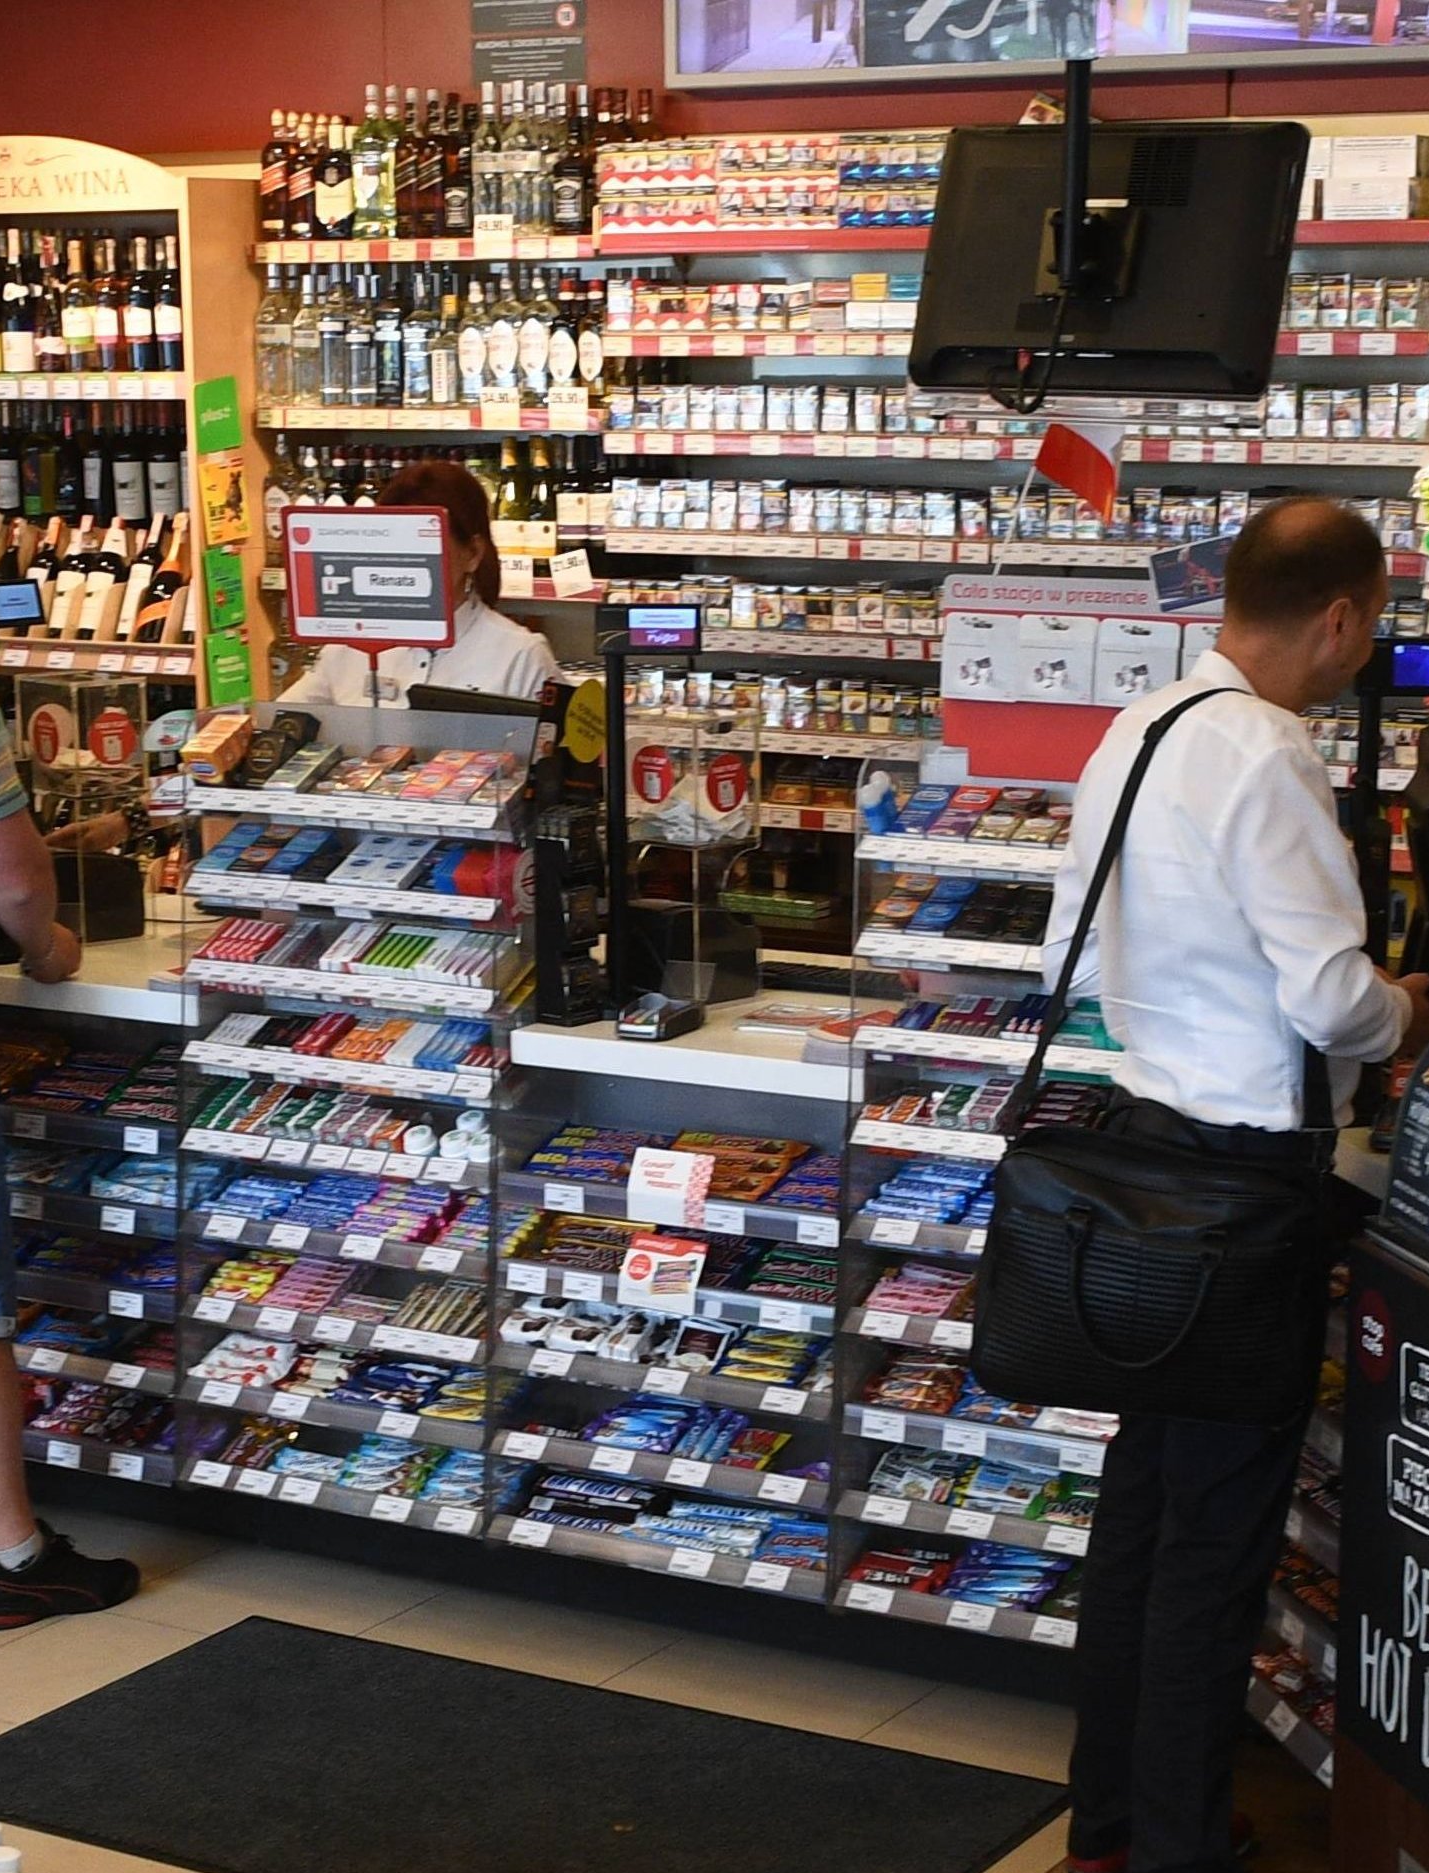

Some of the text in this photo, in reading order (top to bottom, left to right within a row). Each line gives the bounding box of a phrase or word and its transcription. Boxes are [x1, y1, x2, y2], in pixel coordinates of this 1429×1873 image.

[54, 169, 130, 196] WINA
[369, 572, 416, 588] Renata
[993, 585, 1042, 604] stacja
[1047, 590, 1062, 602] w
[1065, 589, 1149, 605] prezencie
[1359, 1612, 1413, 1743] HOT
